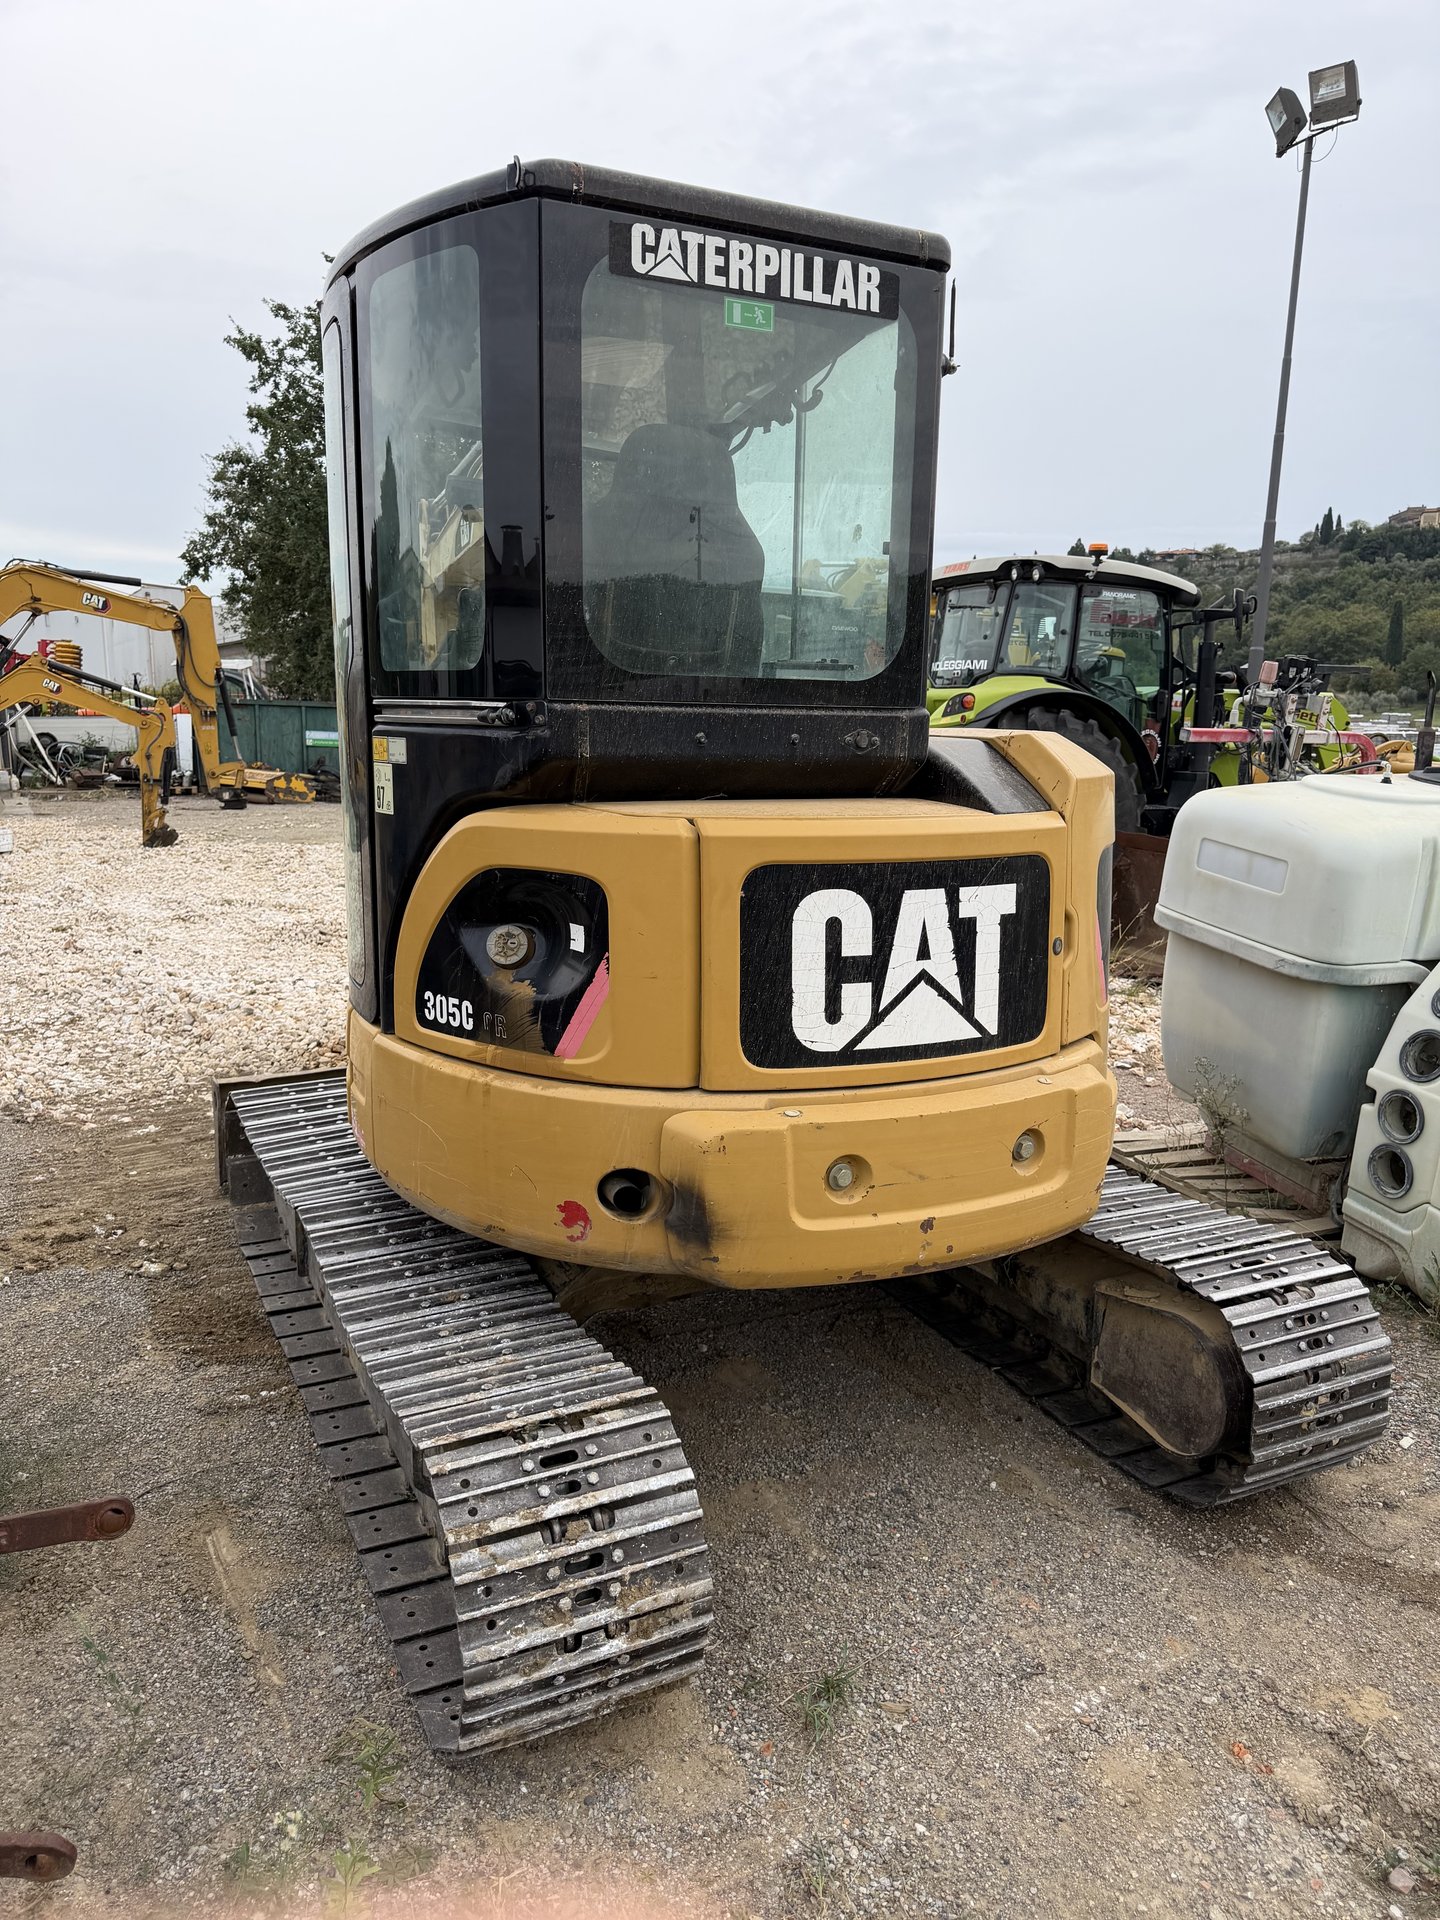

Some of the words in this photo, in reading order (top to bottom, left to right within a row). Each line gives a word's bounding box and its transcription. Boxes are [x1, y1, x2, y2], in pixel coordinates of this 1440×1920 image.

[631, 222, 881, 313] CATERPILLAR
[82, 591, 106, 610] CAT
[1102, 590, 1137, 599] PANORAMIC
[931, 660, 988, 672] NOLEGGIAMI
[42, 678, 60, 692] CAT
[376, 785, 385, 810] 97
[791, 883, 1017, 1052] CAT
[424, 990, 474, 1031] 305C
